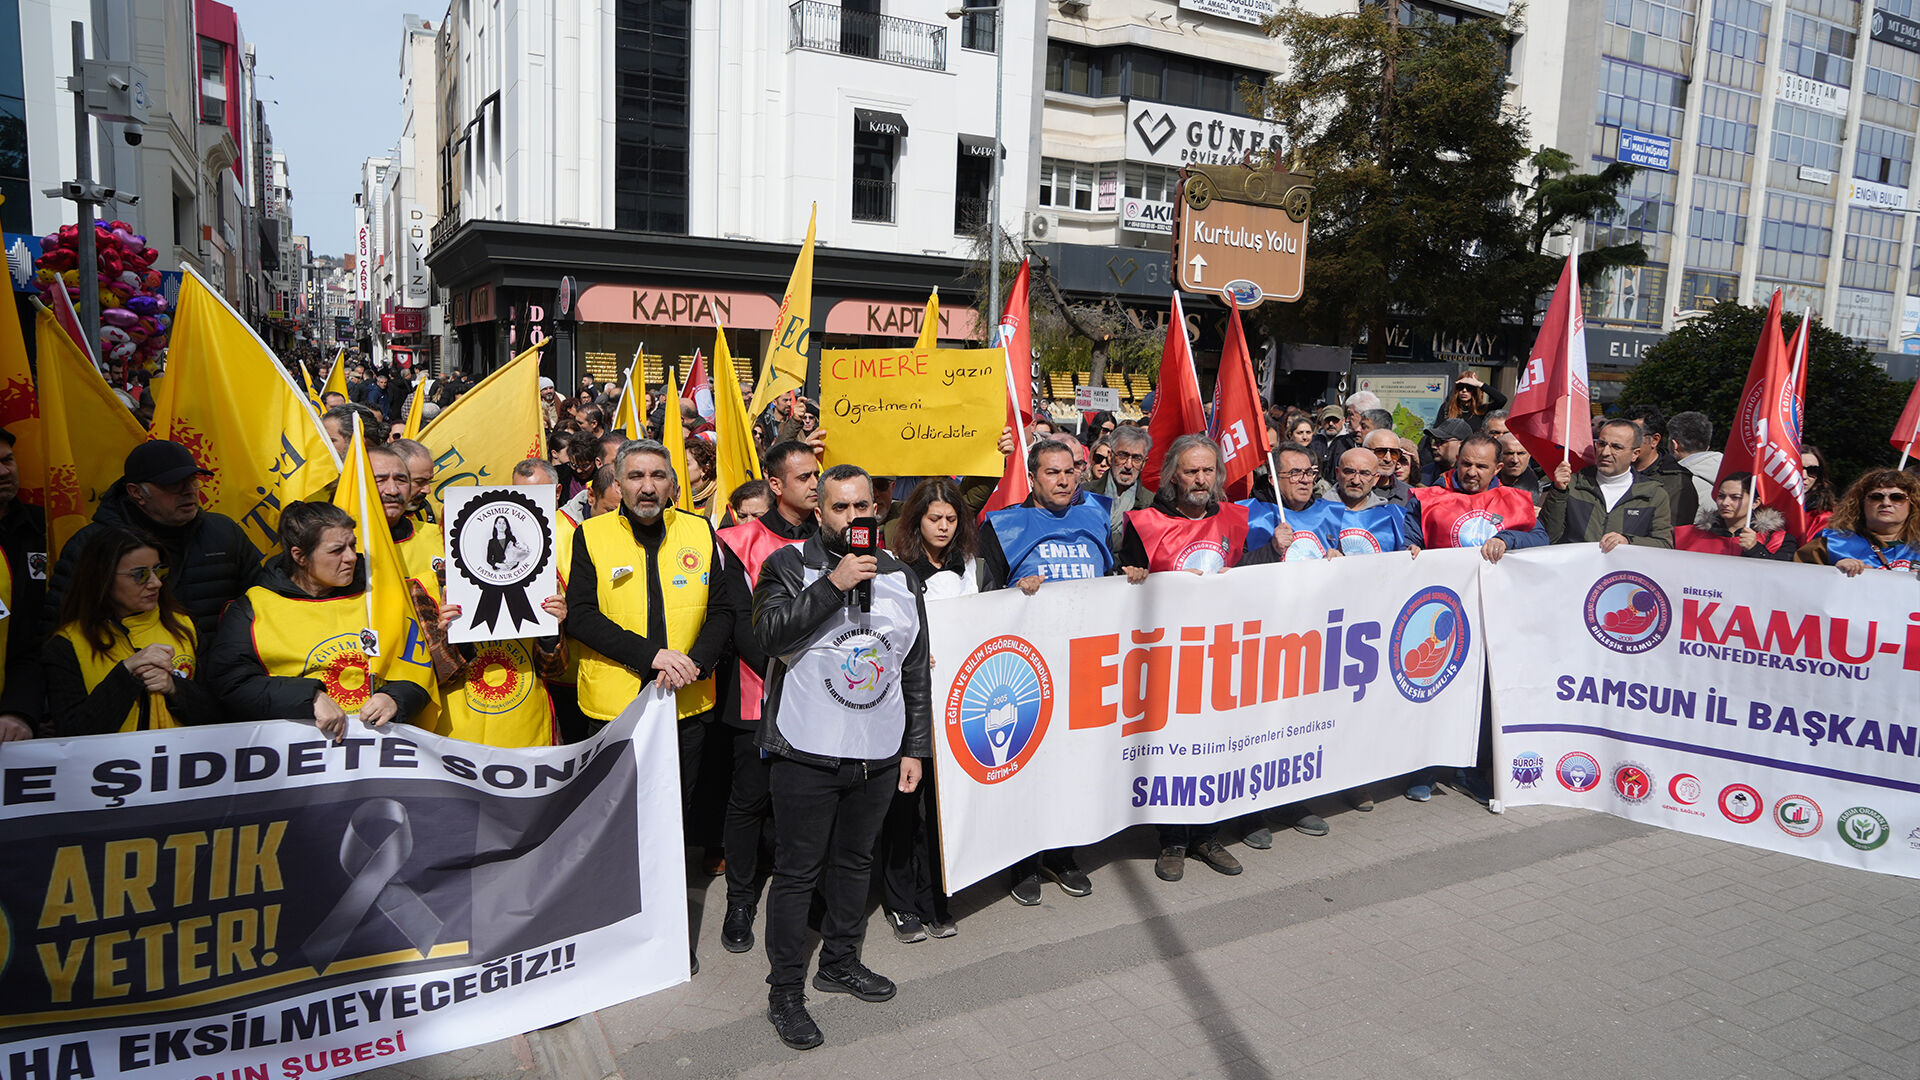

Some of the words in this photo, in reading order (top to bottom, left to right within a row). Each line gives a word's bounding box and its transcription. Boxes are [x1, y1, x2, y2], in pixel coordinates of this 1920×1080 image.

[1785, 75, 1837, 99] SİGORTAM
[1785, 90, 1820, 106] OFFICE
[411, 210, 423, 285] DÖVİZ
[1193, 220, 1262, 253] Kurtuluş
[1265, 229, 1297, 254] Yolu
[632, 290, 731, 323] KAPTAN
[942, 365, 993, 386] yazın
[834, 394, 923, 425] Öğretmeni
[900, 422, 978, 441] Öldürdüler
[476, 507, 510, 522] YASIMIZ
[511, 509, 527, 522] VAR
[1038, 542, 1091, 559] EMEK
[477, 565, 497, 580] FATMA
[499, 573, 513, 581] NUR
[1037, 563, 1096, 580] EYLEM
[1682, 585, 1723, 599] BİRLEŞİK
[1591, 625, 1623, 651] BİRLEŞİK
[1626, 633, 1662, 652] KAMU-İŞ
[1679, 597, 1920, 672] KAMU-İ
[506, 643, 527, 665] SEN
[1679, 640, 1871, 682] KONFEDERASYONU
[948, 687, 961, 725] EĞİTİM
[956, 673, 968, 687] VE
[966, 651, 985, 674] BİLİM
[984, 638, 1031, 657] İŞGÖRENLERİ
[1028, 652, 1051, 700] SENDİKASI
[1395, 672, 1426, 699] BİRLEŞİK
[1427, 663, 1458, 697] KAMU-İŞ
[993, 694, 1008, 706] 2005
[1556, 673, 1698, 722] SAMSUN
[1704, 687, 1738, 727] İL
[1748, 700, 1920, 758] BAŞKAN
[1122, 743, 1164, 762] Eğitim
[1168, 742, 1187, 756] Ve
[1191, 740, 1226, 756] Bilim
[1228, 726, 1284, 755] İşgörenleri
[1286, 719, 1336, 739] Sendikası
[90, 737, 420, 807] ŞİDDETE
[986, 761, 1019, 782] EĞİTİM-İŞ
[1132, 767, 1246, 809] SAMSUN
[1248, 744, 1323, 801] ŞUBESİ
[1512, 757, 1544, 767] BÜRO-İŞ
[1662, 804, 1679, 812] GENEL
[1840, 807, 1858, 823] TARIM
[1858, 807, 1886, 825] ORMAN
[37, 820, 289, 930] ARTIK
[36, 903, 282, 1003] YETER!
[0, 1042, 96, 1080] HA
[119, 942, 577, 1073] EKSİLMEYECEĞİZ!!
[281, 1028, 407, 1080] ŞUBESİ
